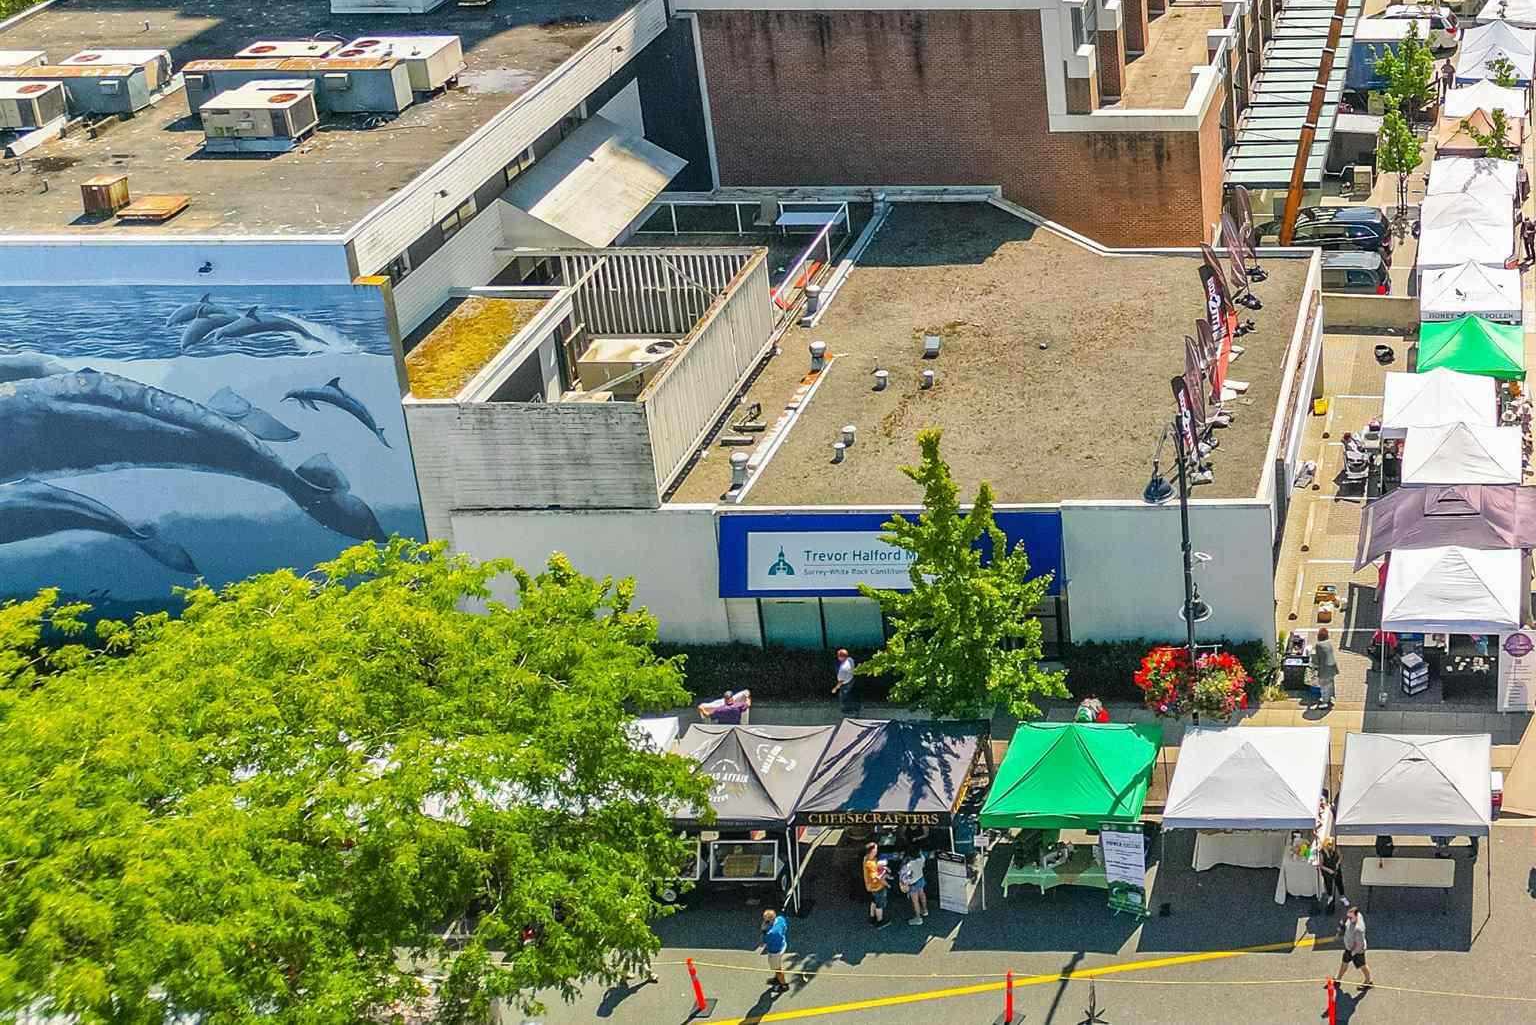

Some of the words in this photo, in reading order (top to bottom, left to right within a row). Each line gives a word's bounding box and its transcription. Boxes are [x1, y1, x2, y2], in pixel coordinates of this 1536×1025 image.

[804, 550, 847, 561] Trevor
[852, 549, 901, 561] Halford
[808, 812, 940, 825] CHEESECRAFTERS
